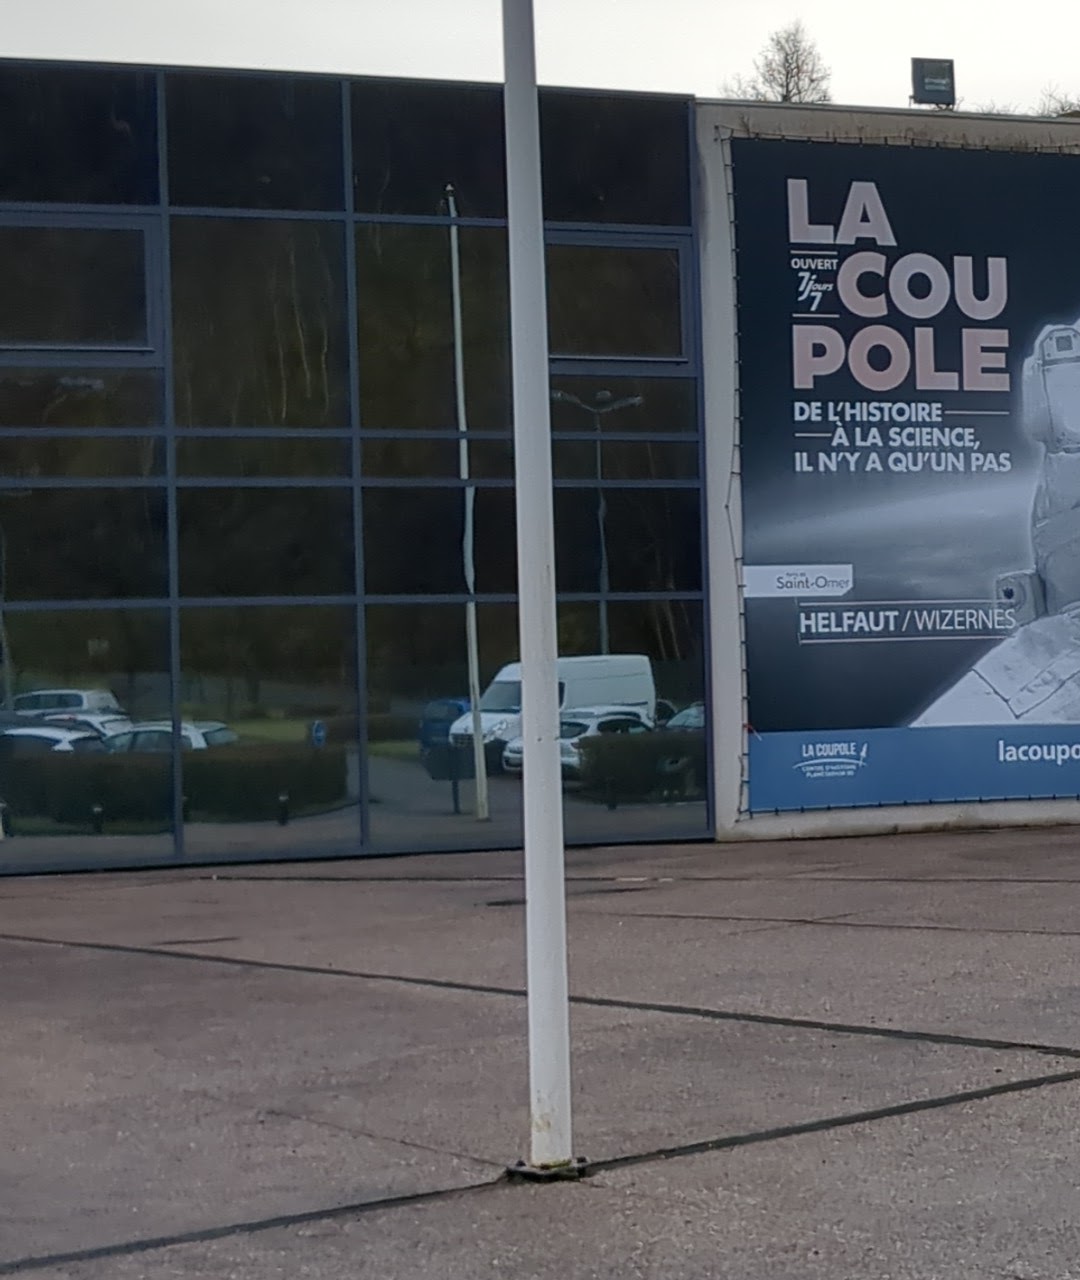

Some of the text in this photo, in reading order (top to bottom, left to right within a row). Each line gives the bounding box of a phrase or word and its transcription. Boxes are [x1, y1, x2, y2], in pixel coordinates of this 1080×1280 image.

[787, 178, 898, 247] LA
[791, 257, 839, 270] OUVERT
[837, 251, 1008, 320] COU
[810, 291, 823, 312] 7
[792, 324, 1011, 392] POLE
[794, 402, 942, 422] DE L'HISTOIRE
[831, 420, 981, 450] À LA SCIENCE,
[795, 452, 1012, 473] IL N'Y A QU'UN PAS
[776, 575, 850, 590] Saint-Omer
[800, 610, 899, 634] HELFAUT
[914, 609, 1016, 631] WIZERNES
[802, 742, 857, 758] LA COUPOLE
